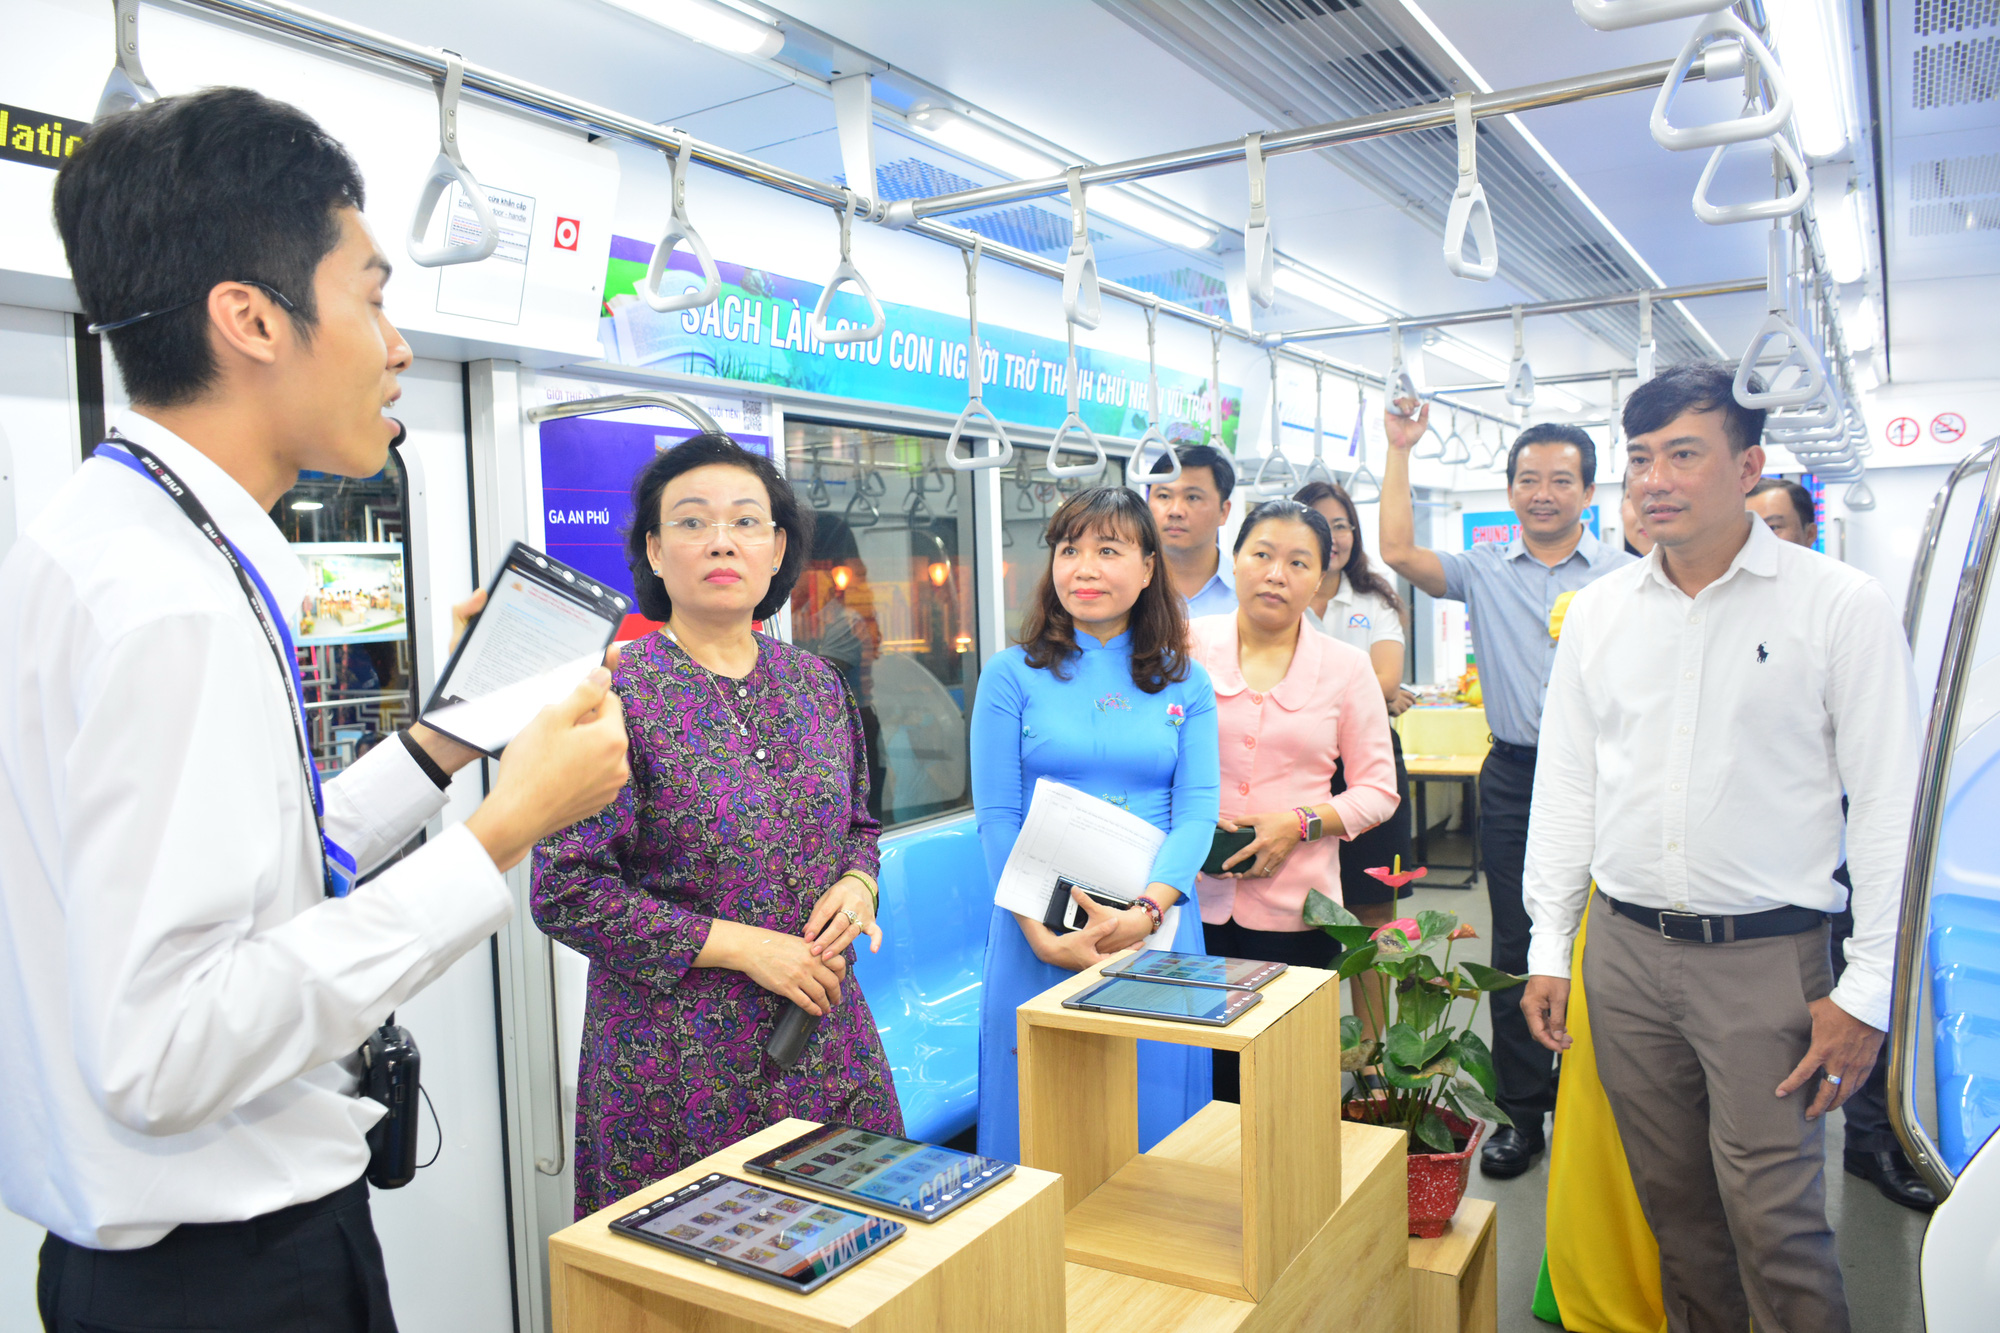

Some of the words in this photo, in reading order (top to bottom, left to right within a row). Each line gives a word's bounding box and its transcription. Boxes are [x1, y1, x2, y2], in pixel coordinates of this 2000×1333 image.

[889, 329, 934, 374] CON
[938, 340, 999, 385] NGỜI
[1004, 349, 1040, 392] TRỞ
[1096, 369, 1126, 407] CHỦ
[548, 509, 566, 524] GA
[567, 509, 585, 524] AN
[586, 507, 610, 525] PHÚ
[1472, 524, 1509, 543] CHUNG
